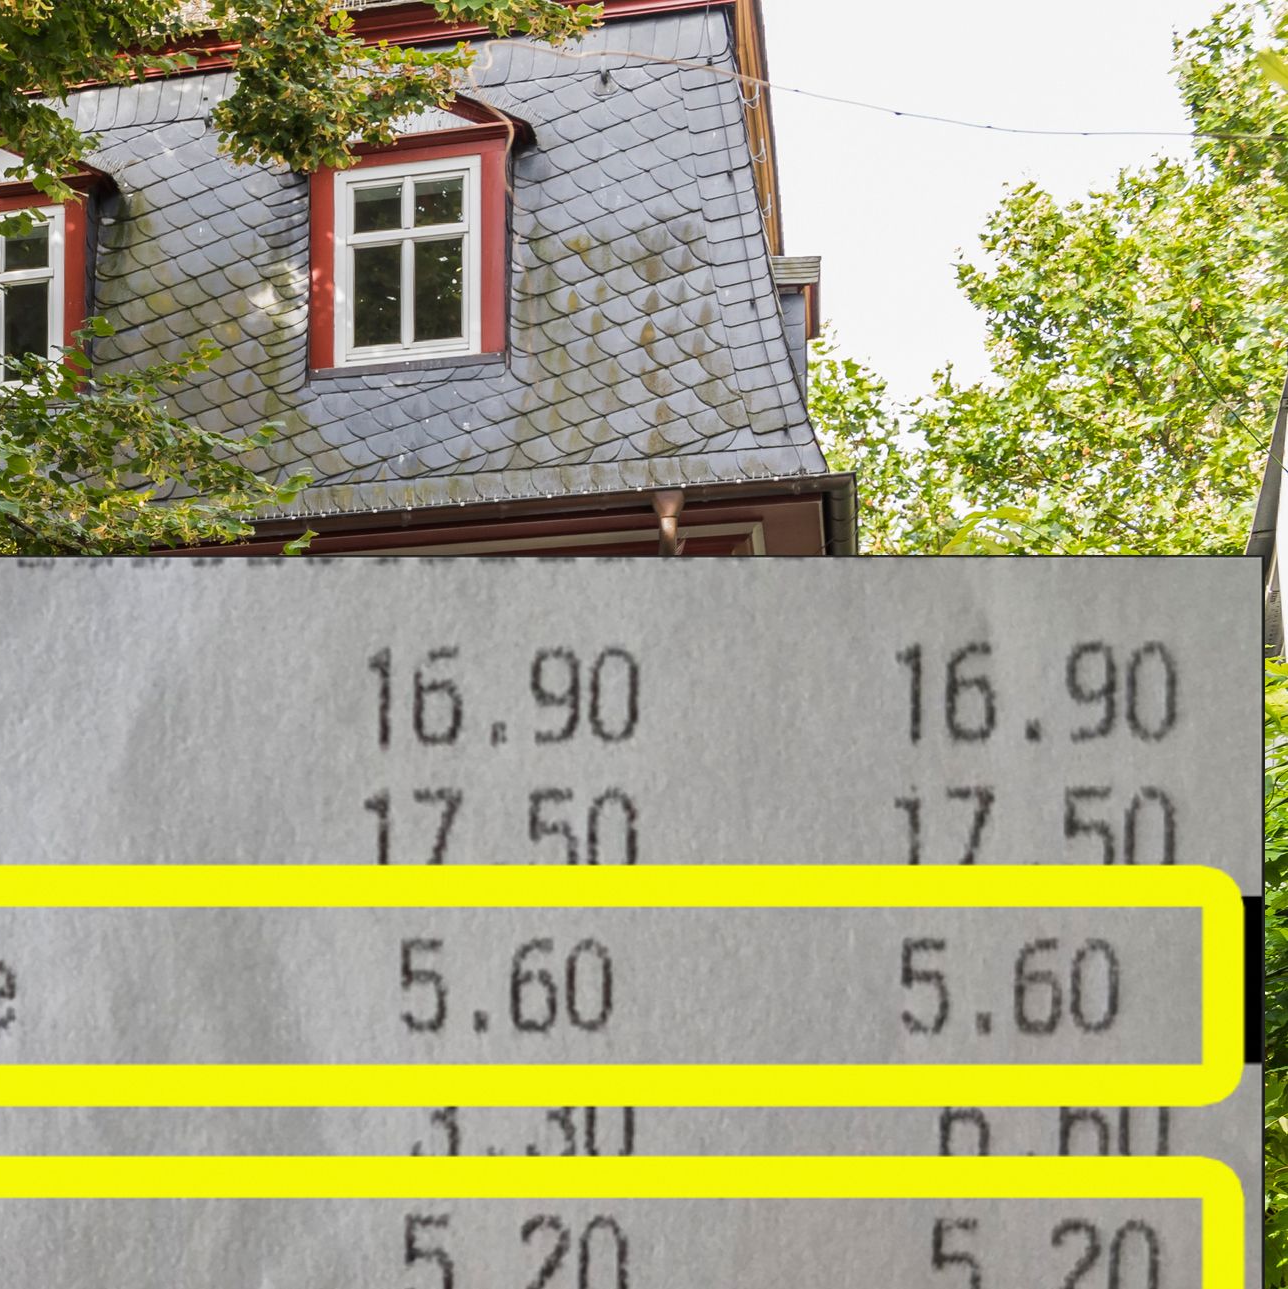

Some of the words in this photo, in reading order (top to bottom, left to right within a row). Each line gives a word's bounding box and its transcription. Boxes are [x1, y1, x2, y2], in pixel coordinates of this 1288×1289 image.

[369, 647, 639, 748] 16.90
[897, 642, 1177, 744] 16.90
[363, 787, 637, 865] 1750
[894, 785, 1177, 865] 1750
[401, 939, 612, 1033] 5.60
[902, 939, 1119, 1034] 5.60
